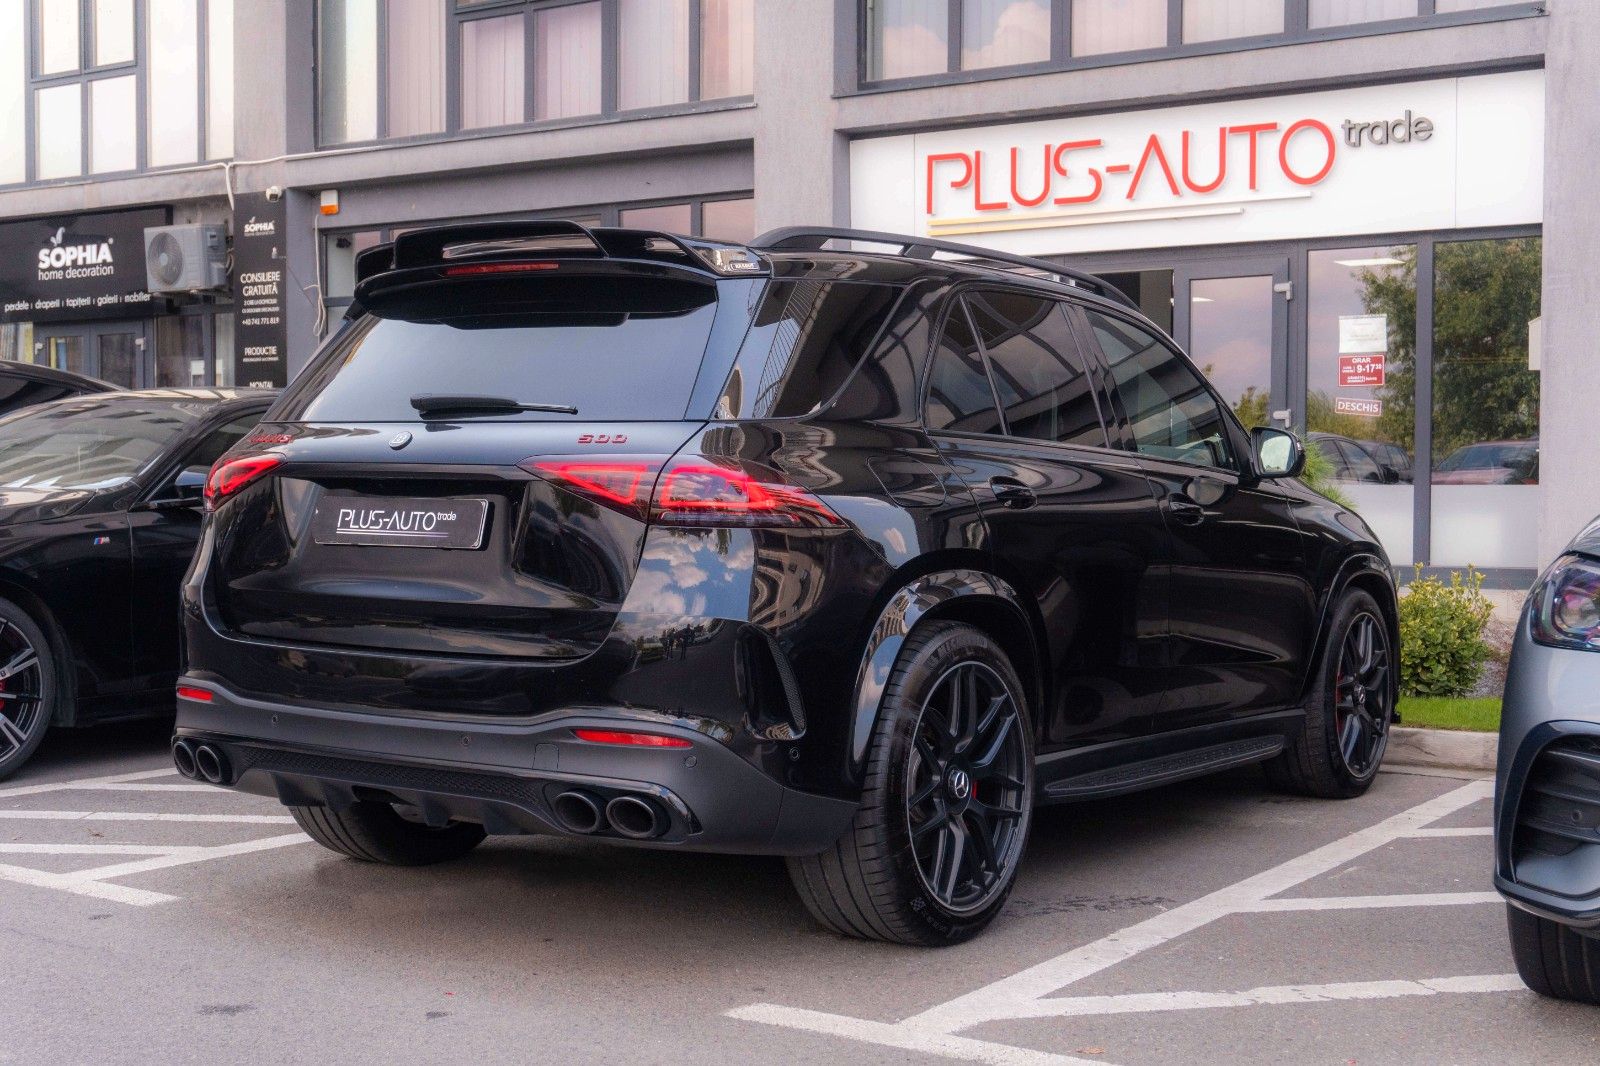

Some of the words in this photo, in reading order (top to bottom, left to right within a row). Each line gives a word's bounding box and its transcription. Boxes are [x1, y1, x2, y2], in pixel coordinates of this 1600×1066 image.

[926, 118, 1336, 215] PLUS-AUTO
[1341, 110, 1434, 147] trade
[244, 222, 274, 233] SOPHIA
[38, 242, 113, 269] SOPHIA
[38, 270, 64, 280] home
[65, 264, 114, 279] decoration
[240, 271, 281, 284] CONSILIERE
[4, 300, 30, 313] perdele
[1338, 401, 1379, 412] DESCHIS
[577, 434, 628, 444] 500
[337, 509, 437, 531] PLUS-AUTO
[436, 512, 457, 521] trade
